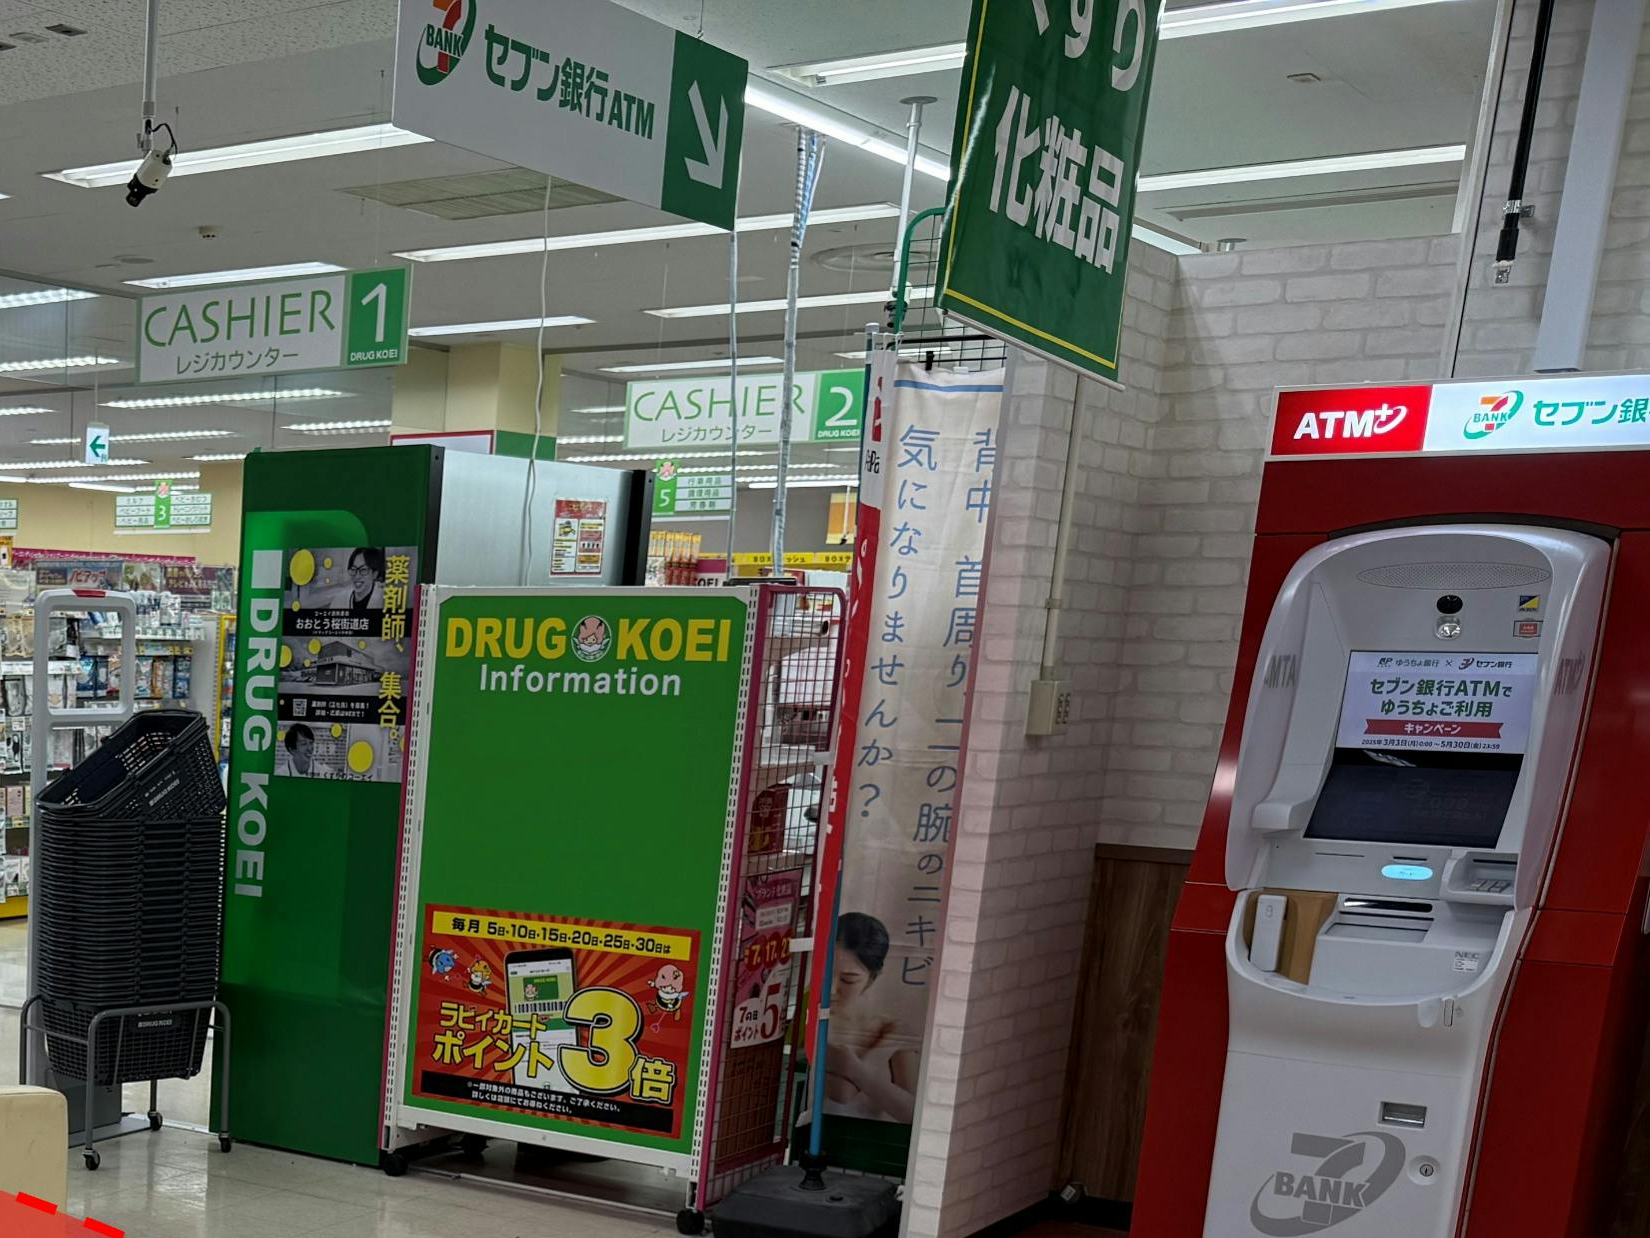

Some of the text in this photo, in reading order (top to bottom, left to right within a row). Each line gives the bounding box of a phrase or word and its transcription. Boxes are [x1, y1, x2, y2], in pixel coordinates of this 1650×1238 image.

[426, 24, 464, 57] BANK
[485, 24, 655, 139] セブン銀行ATM
[990, 85, 1124, 274] 化粧品
[144, 282, 387, 347] CASHIER 1
[177, 347, 299, 375] レジカウンター
[350, 349, 398, 361] DRUG KOEI
[634, 384, 858, 427] CASHIER 2
[1474, 410, 1507, 422] BANK
[661, 425, 772, 443] レジカウンター
[818, 430, 839, 438] DRUG
[659, 489, 670, 507] 5
[158, 505, 167, 521] 3
[296, 618, 370, 630] おおとう桜街道店
[858, 424, 941, 818] 気になりませんか？
[446, 617, 732, 662] DRUG KOEI
[1395, 658, 1440, 668] ゆうちょ銀行
[1476, 660, 1513, 669] セブン銀行
[480, 664, 681, 696] Information
[1370, 677, 1513, 698] セブン銀行ATMで
[1380, 699, 1493, 717] ゆうちょご利用
[1404, 722, 1461, 735] キャンペーン
[234, 598, 280, 897] DRUG KOEI
[452, 917, 480, 934] 毎月
[1454, 951, 1478, 959] NEC
[734, 982, 781, 1043] ポイント 5
[432, 986, 677, 1104] ポイント 3 倍
[1273, 1170, 1371, 1208] BANK
